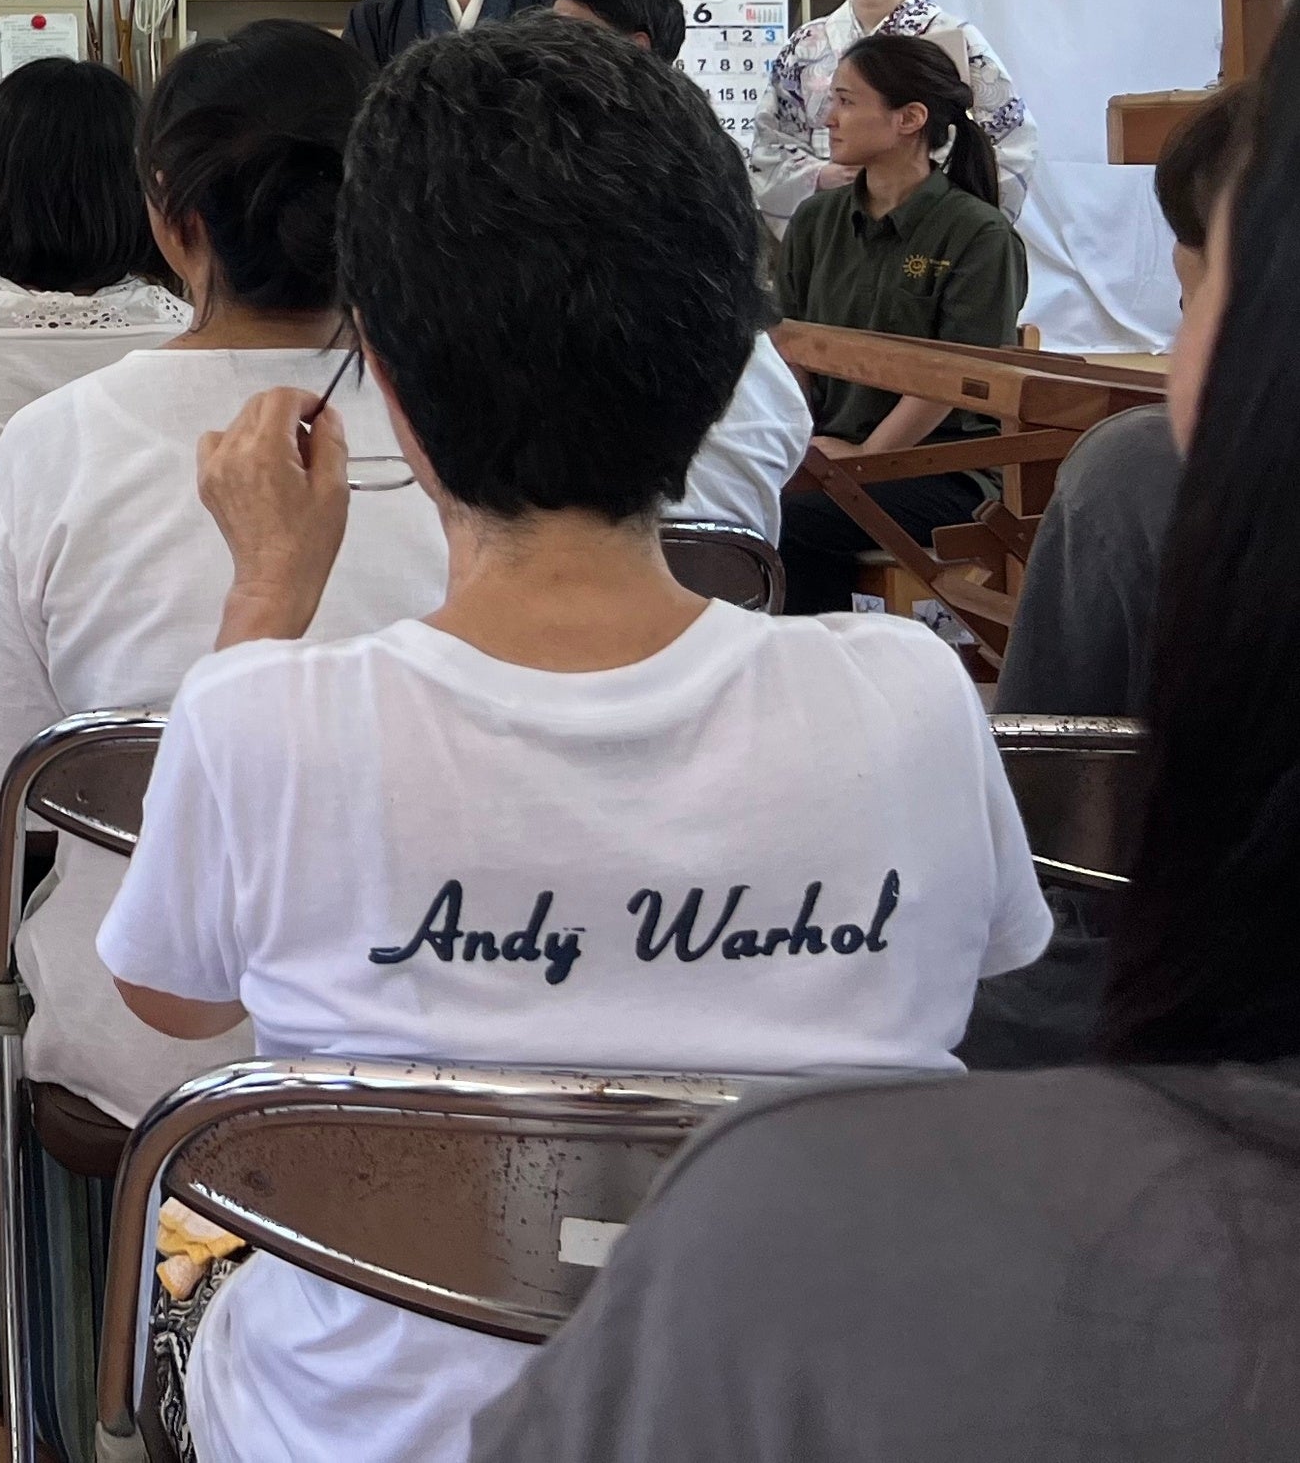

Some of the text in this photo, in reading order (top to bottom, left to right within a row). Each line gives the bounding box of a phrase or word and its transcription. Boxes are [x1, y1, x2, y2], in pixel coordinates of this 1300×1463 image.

[693, 3, 712, 23] 6
[720, 30, 776, 42] 1 2 3
[697, 59, 707, 71] 7
[720, 59, 730, 71] 8
[743, 59, 753, 71] 9
[719, 88, 734, 100] 15
[742, 88, 757, 100] 16
[368, 868, 901, 985] Andy Warhol
